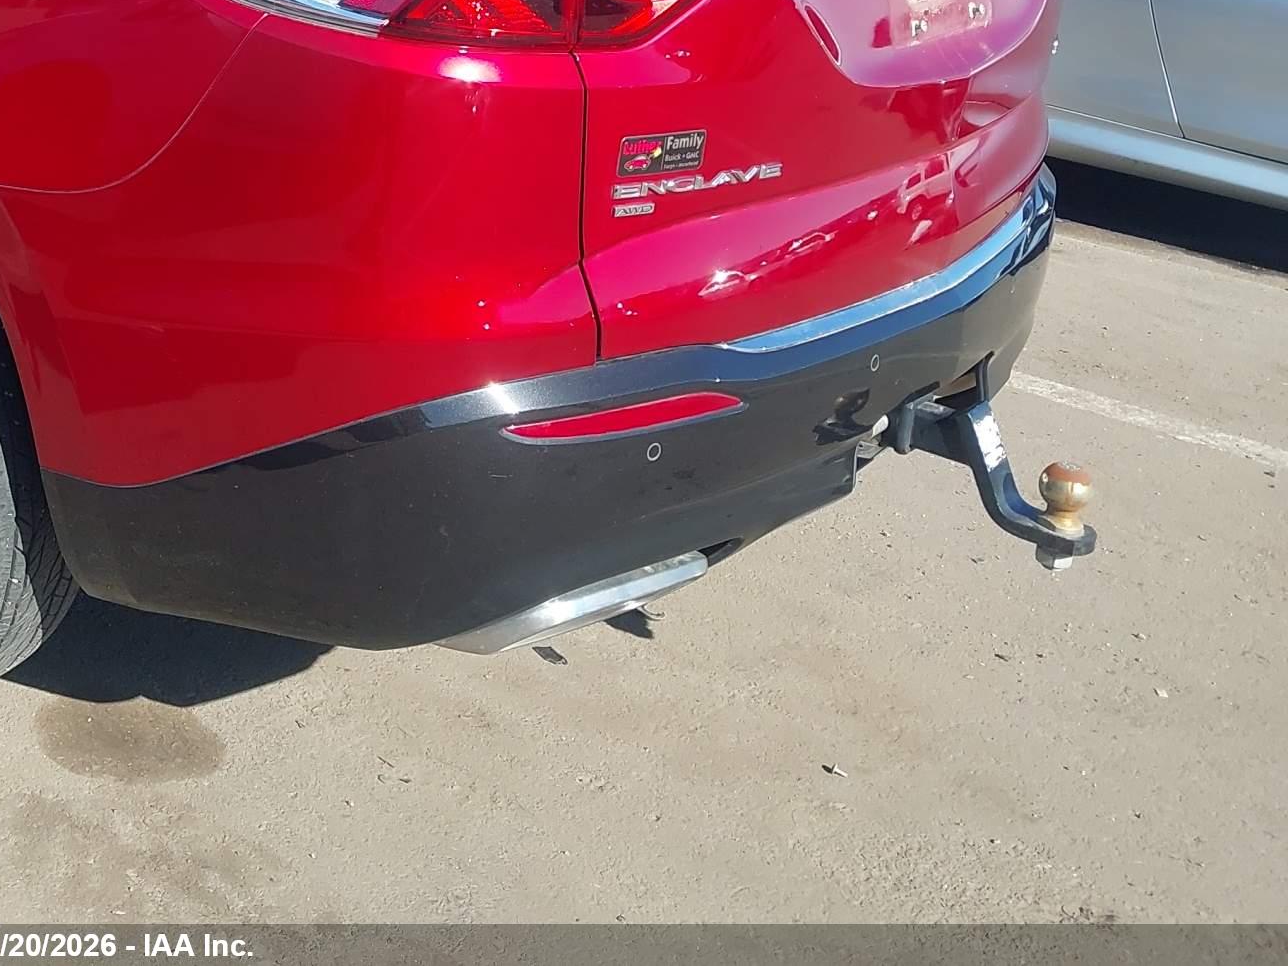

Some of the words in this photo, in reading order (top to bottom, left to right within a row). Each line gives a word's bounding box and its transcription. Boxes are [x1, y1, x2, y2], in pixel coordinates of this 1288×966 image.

[666, 132, 704, 151] Family
[664, 152, 682, 162] Buick
[686, 150, 700, 160] GMC
[611, 162, 784, 200] ENCLAVE
[615, 203, 653, 216] AWD
